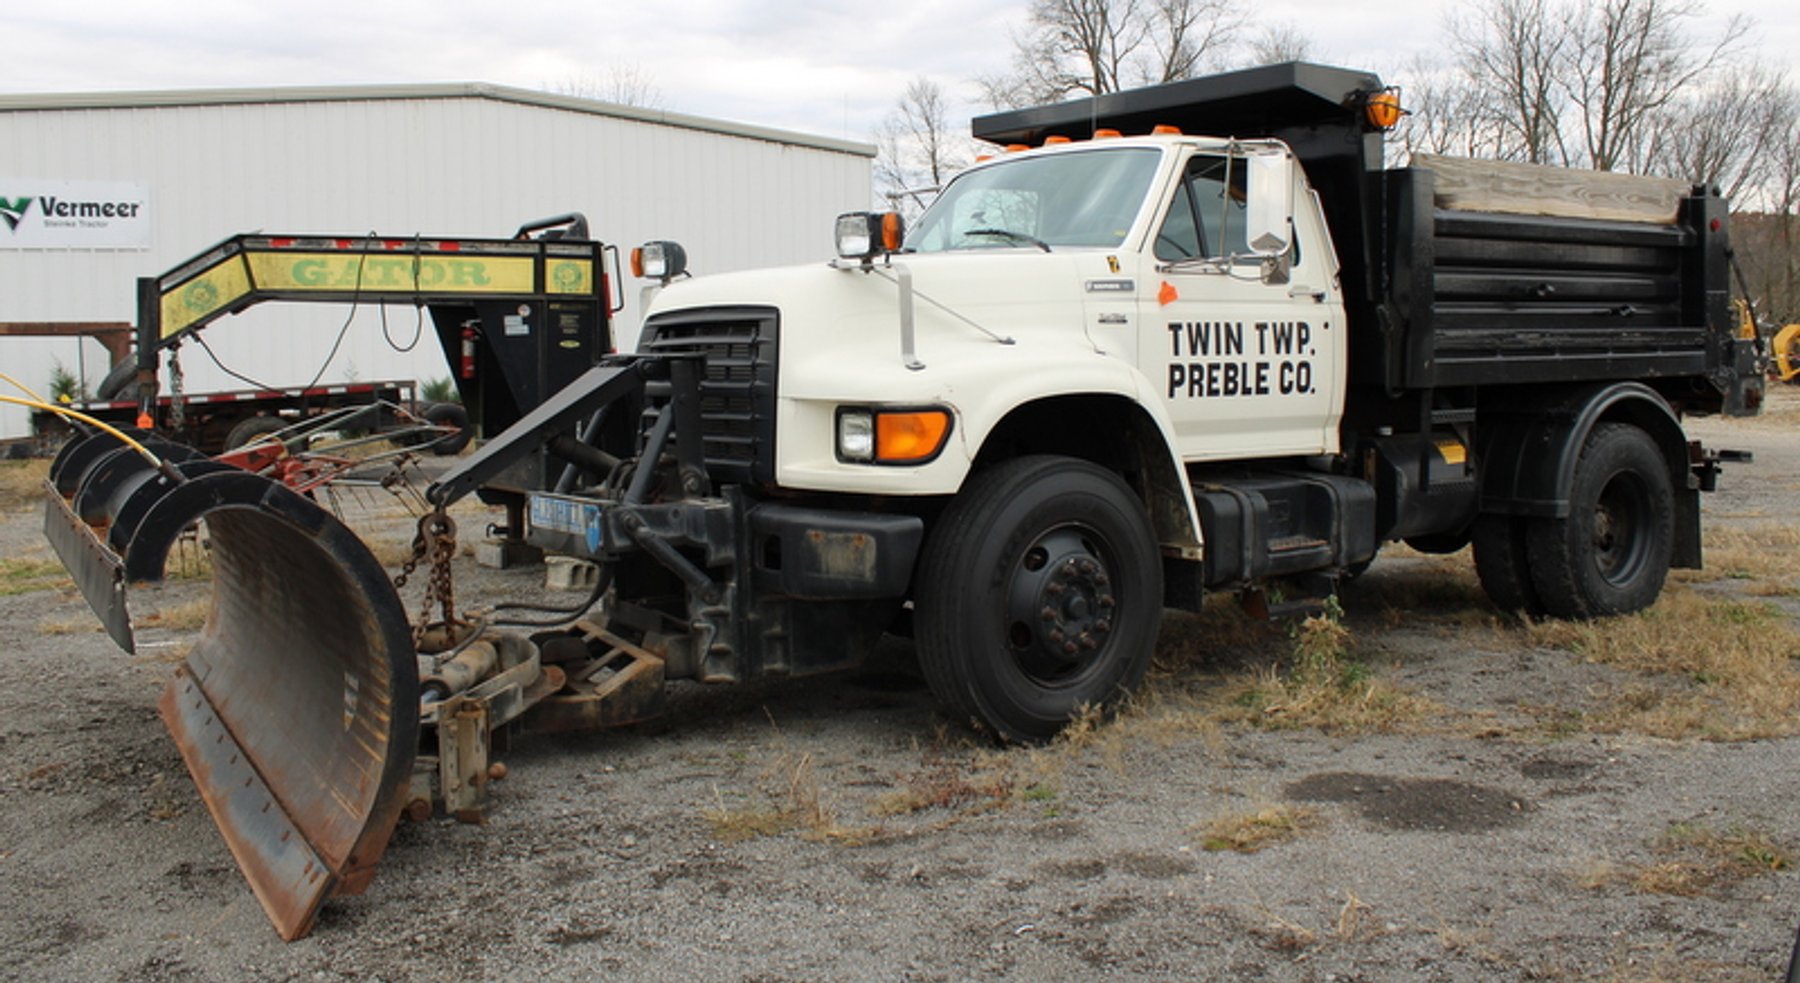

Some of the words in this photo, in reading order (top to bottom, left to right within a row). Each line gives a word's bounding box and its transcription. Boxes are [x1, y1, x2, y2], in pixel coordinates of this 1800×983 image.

[39, 196, 139, 218] Vermeer
[292, 259, 491, 286] GATOR
[1168, 322, 1243, 356] TWIN
[1254, 321, 1315, 355] TWP.
[1168, 361, 1269, 398] PREBLE
[1280, 360, 1316, 395] CO.
